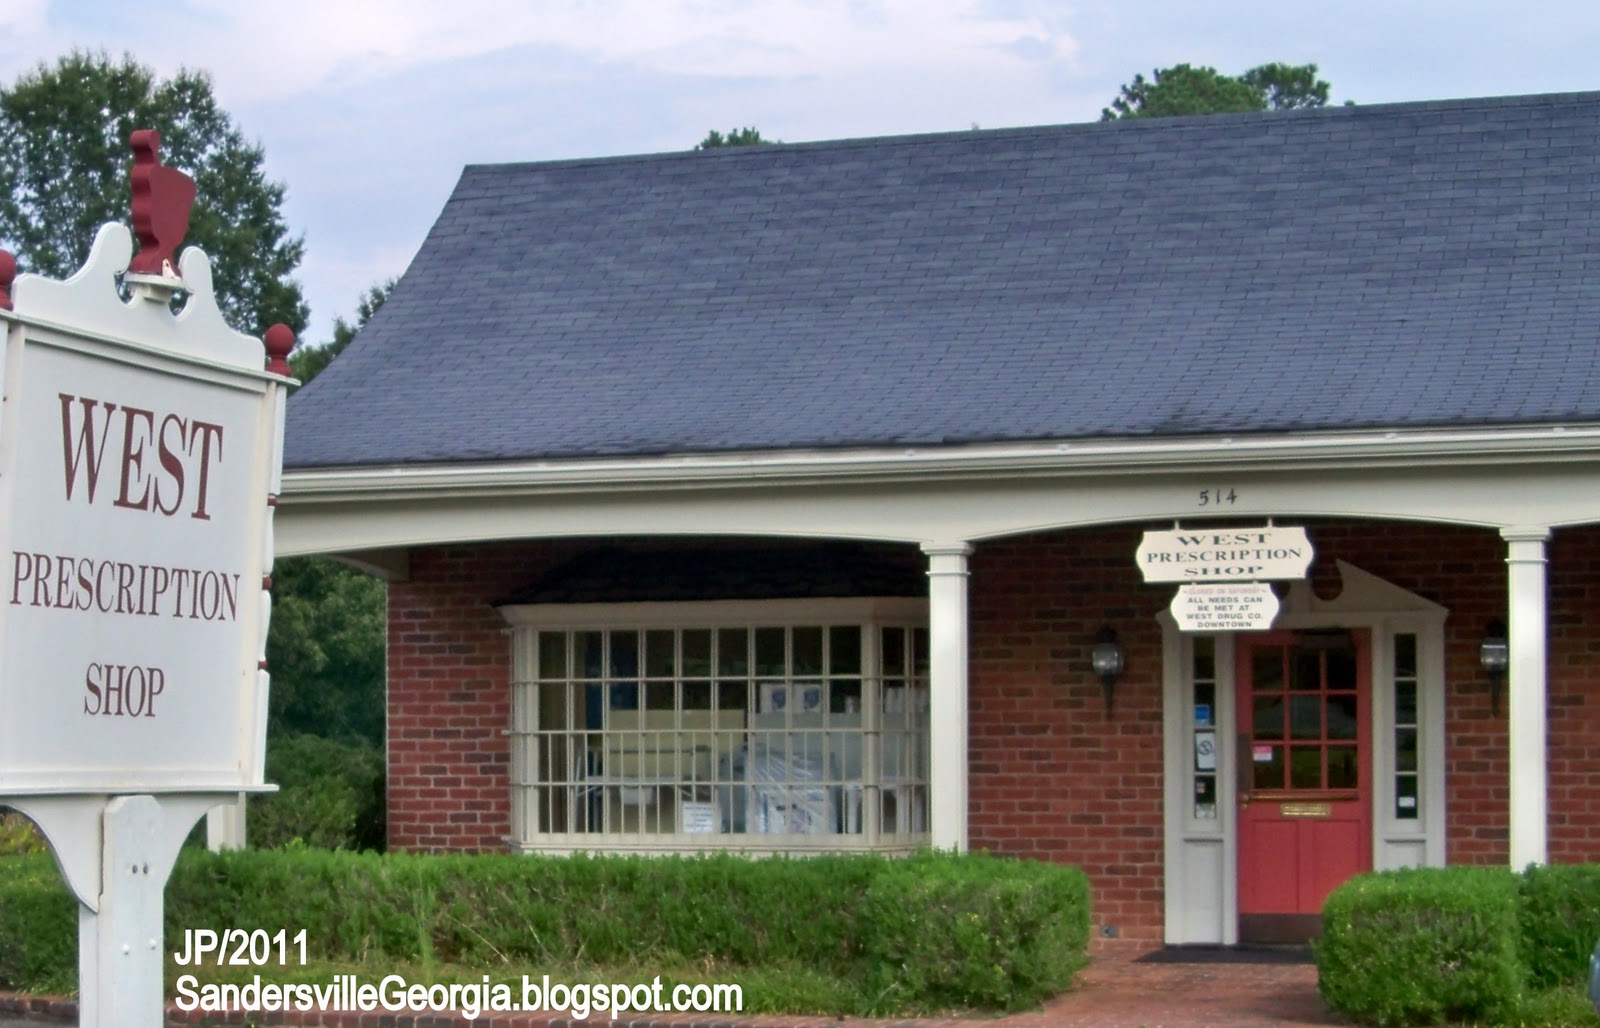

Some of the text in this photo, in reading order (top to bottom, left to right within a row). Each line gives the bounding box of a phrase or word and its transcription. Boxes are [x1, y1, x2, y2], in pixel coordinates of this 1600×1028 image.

[58, 393, 223, 521] WEST
[1198, 488, 1237, 506] 514
[1177, 533, 1271, 546] WEST
[1147, 548, 1301, 563] PRESCRIPTION
[1184, 566, 1263, 576] SHOP
[10, 551, 240, 621] PRESCRIPTION
[83, 662, 165, 718] SHOP
